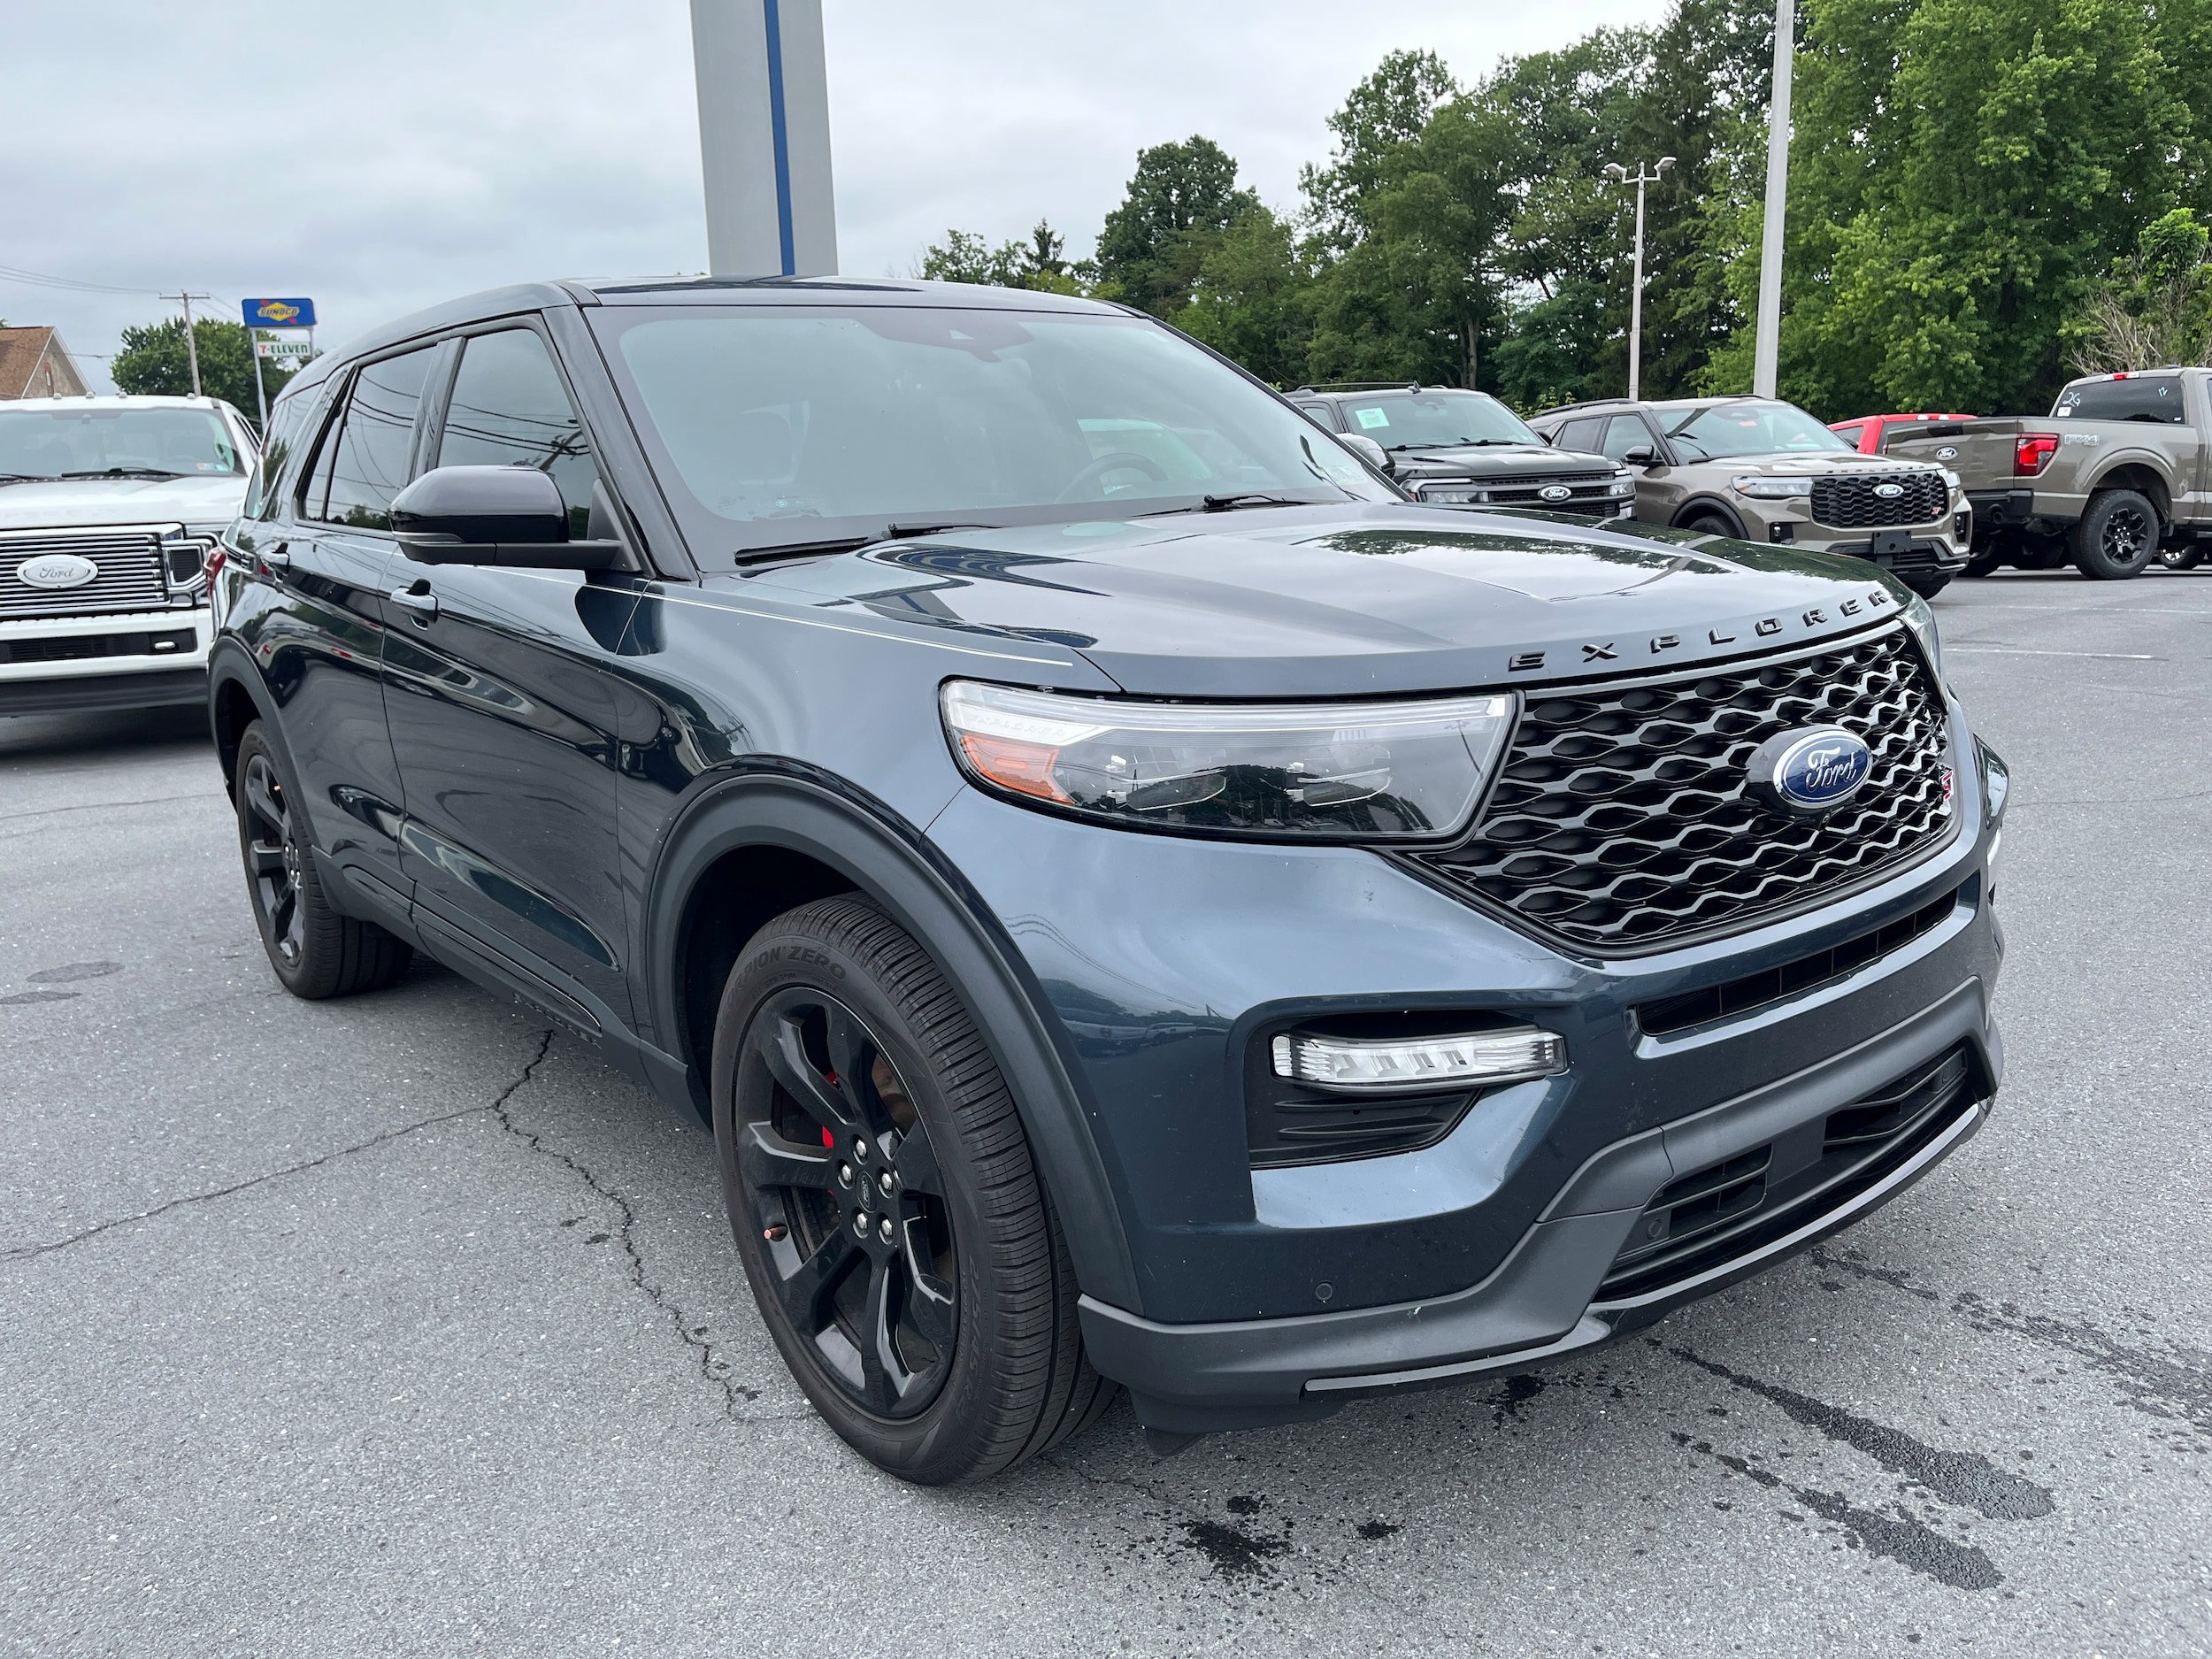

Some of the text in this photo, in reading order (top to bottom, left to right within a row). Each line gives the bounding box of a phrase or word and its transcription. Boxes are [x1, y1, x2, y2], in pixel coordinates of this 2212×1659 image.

[259, 306, 298, 316] SUNOCO
[39, 567, 74, 579] Ford
[1509, 590, 1889, 672] EXPLORER
[1805, 746, 1858, 791] Ford
[787, 945, 847, 981] ZERO
